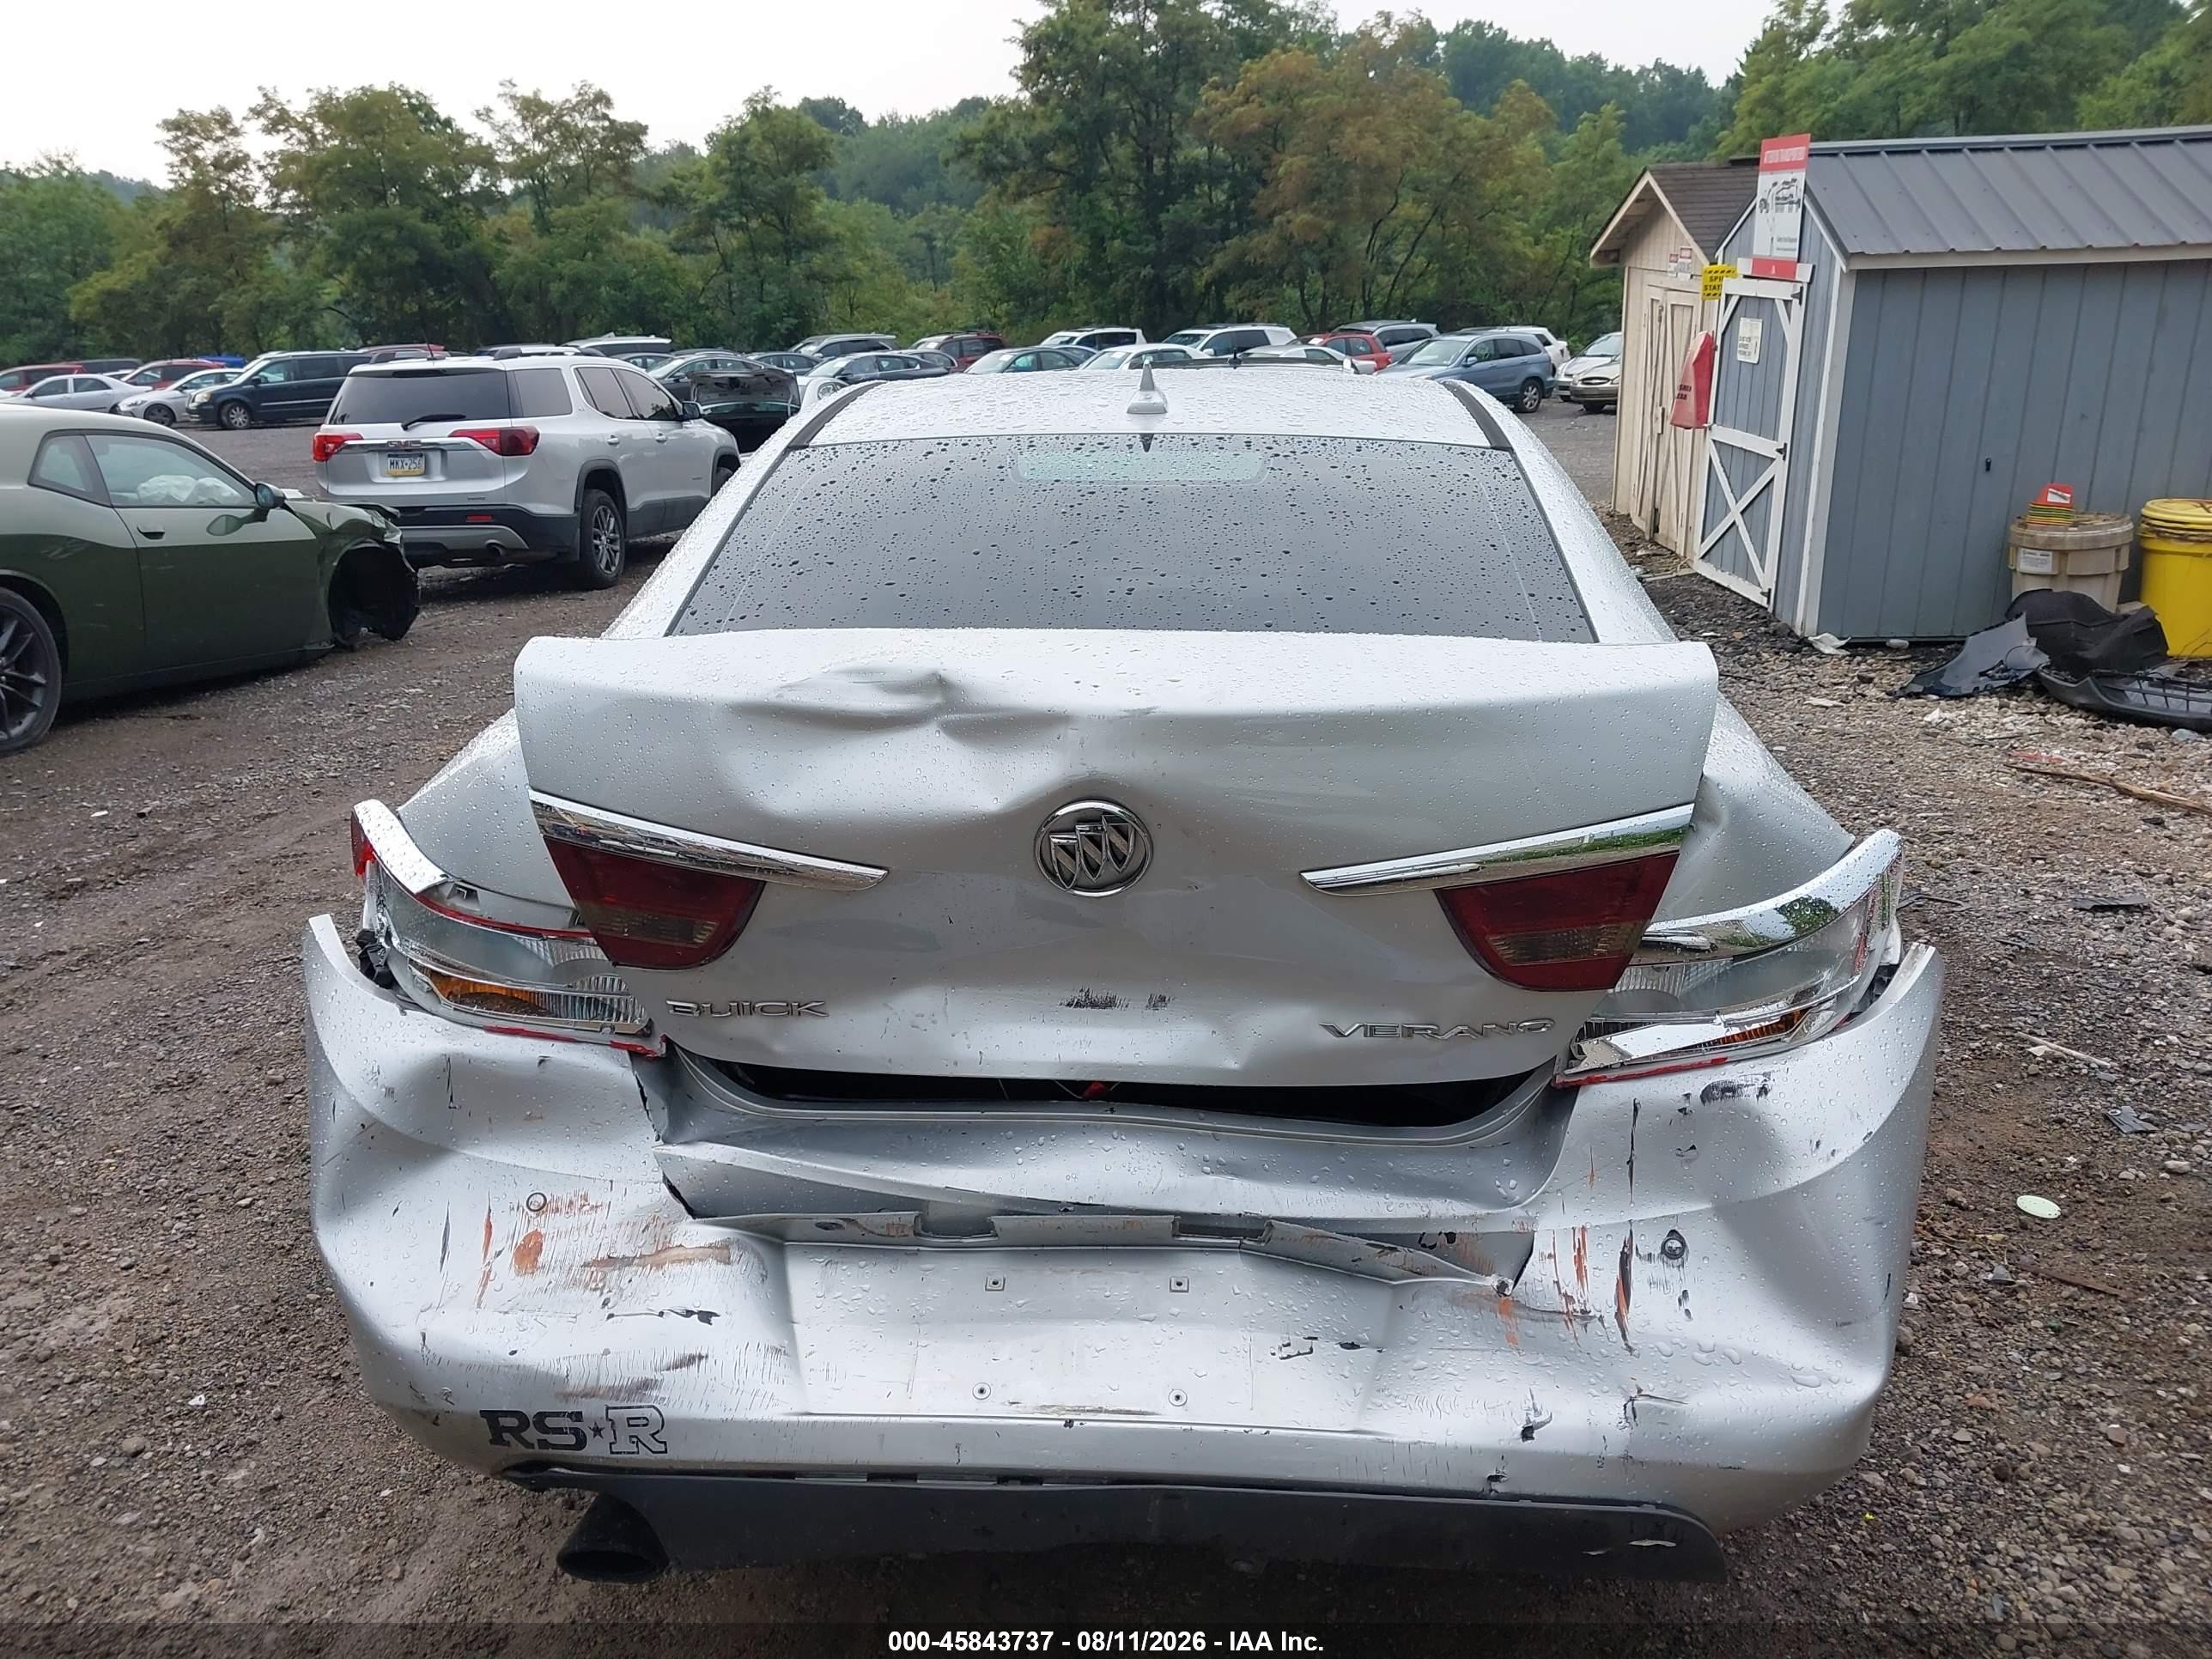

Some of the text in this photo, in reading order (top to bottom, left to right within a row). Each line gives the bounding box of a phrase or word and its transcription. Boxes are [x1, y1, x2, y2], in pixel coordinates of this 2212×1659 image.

[386, 440, 422, 448] GMC
[665, 1000, 830, 1018] BUICK
[1318, 1018, 1556, 1040] VERANO
